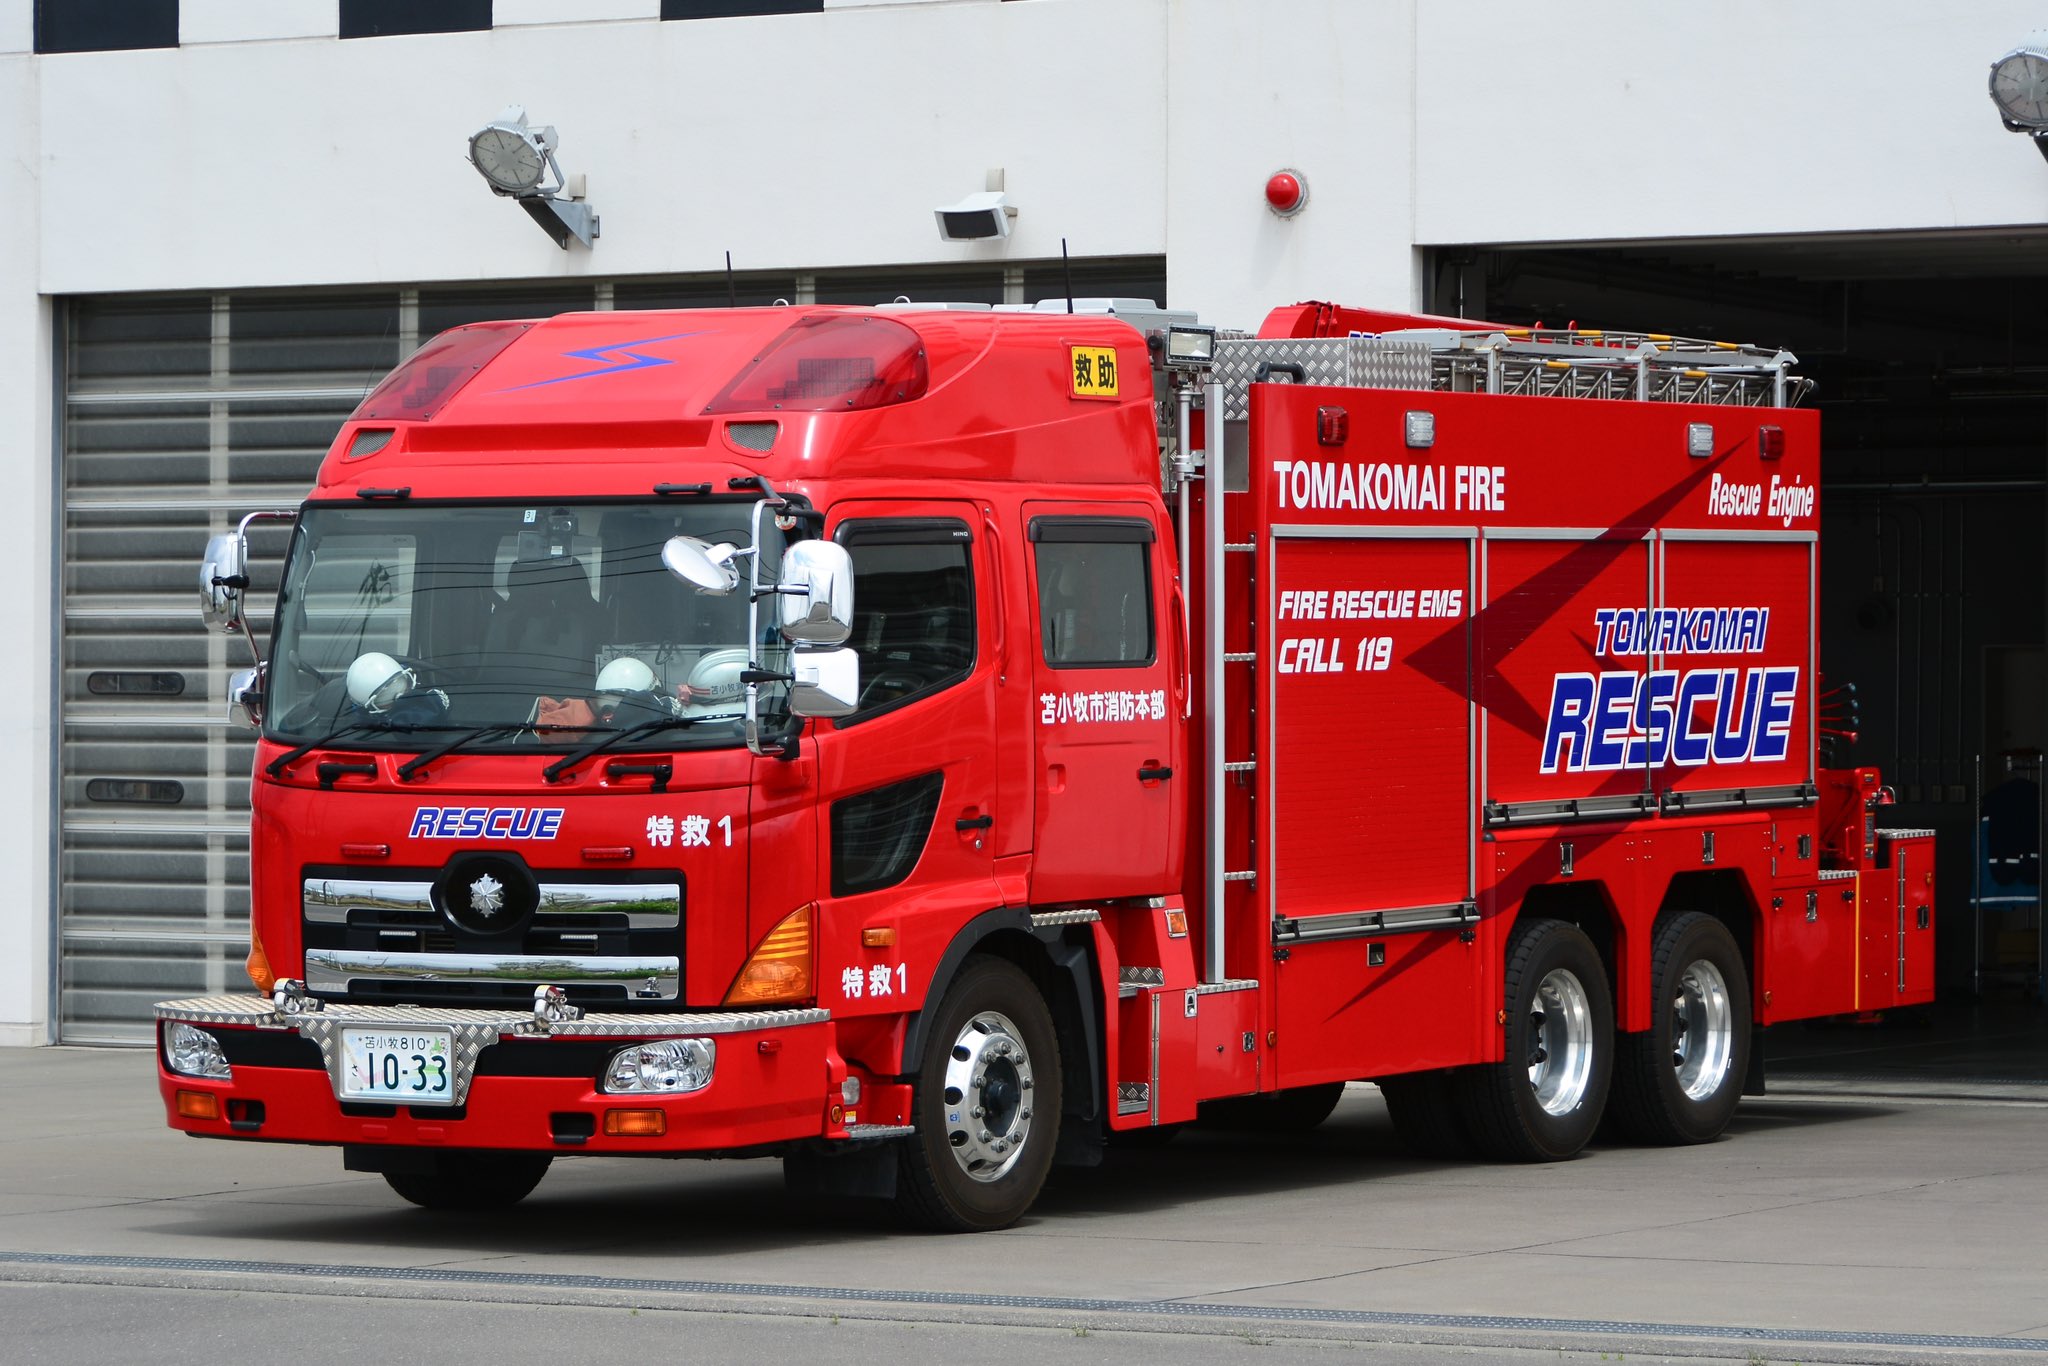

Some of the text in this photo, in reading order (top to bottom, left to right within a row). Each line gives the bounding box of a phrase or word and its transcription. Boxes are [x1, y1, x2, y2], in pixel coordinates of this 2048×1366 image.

[1075, 353, 1115, 389] 救助
[1273, 460, 1505, 511] TOMAKOMAI FIRE
[1708, 472, 1814, 528] Rescue Engine
[1278, 589, 1463, 619] FIRE RESCUE EMS
[1594, 606, 1770, 656] TOMAKOMAI
[1278, 636, 1394, 674] CALL 119
[1040, 689, 1165, 724] 苫小牧市消防本部
[1539, 665, 1800, 775] RESCUE
[408, 806, 565, 840] RESCUE
[368, 1052, 447, 1092] 10-33
